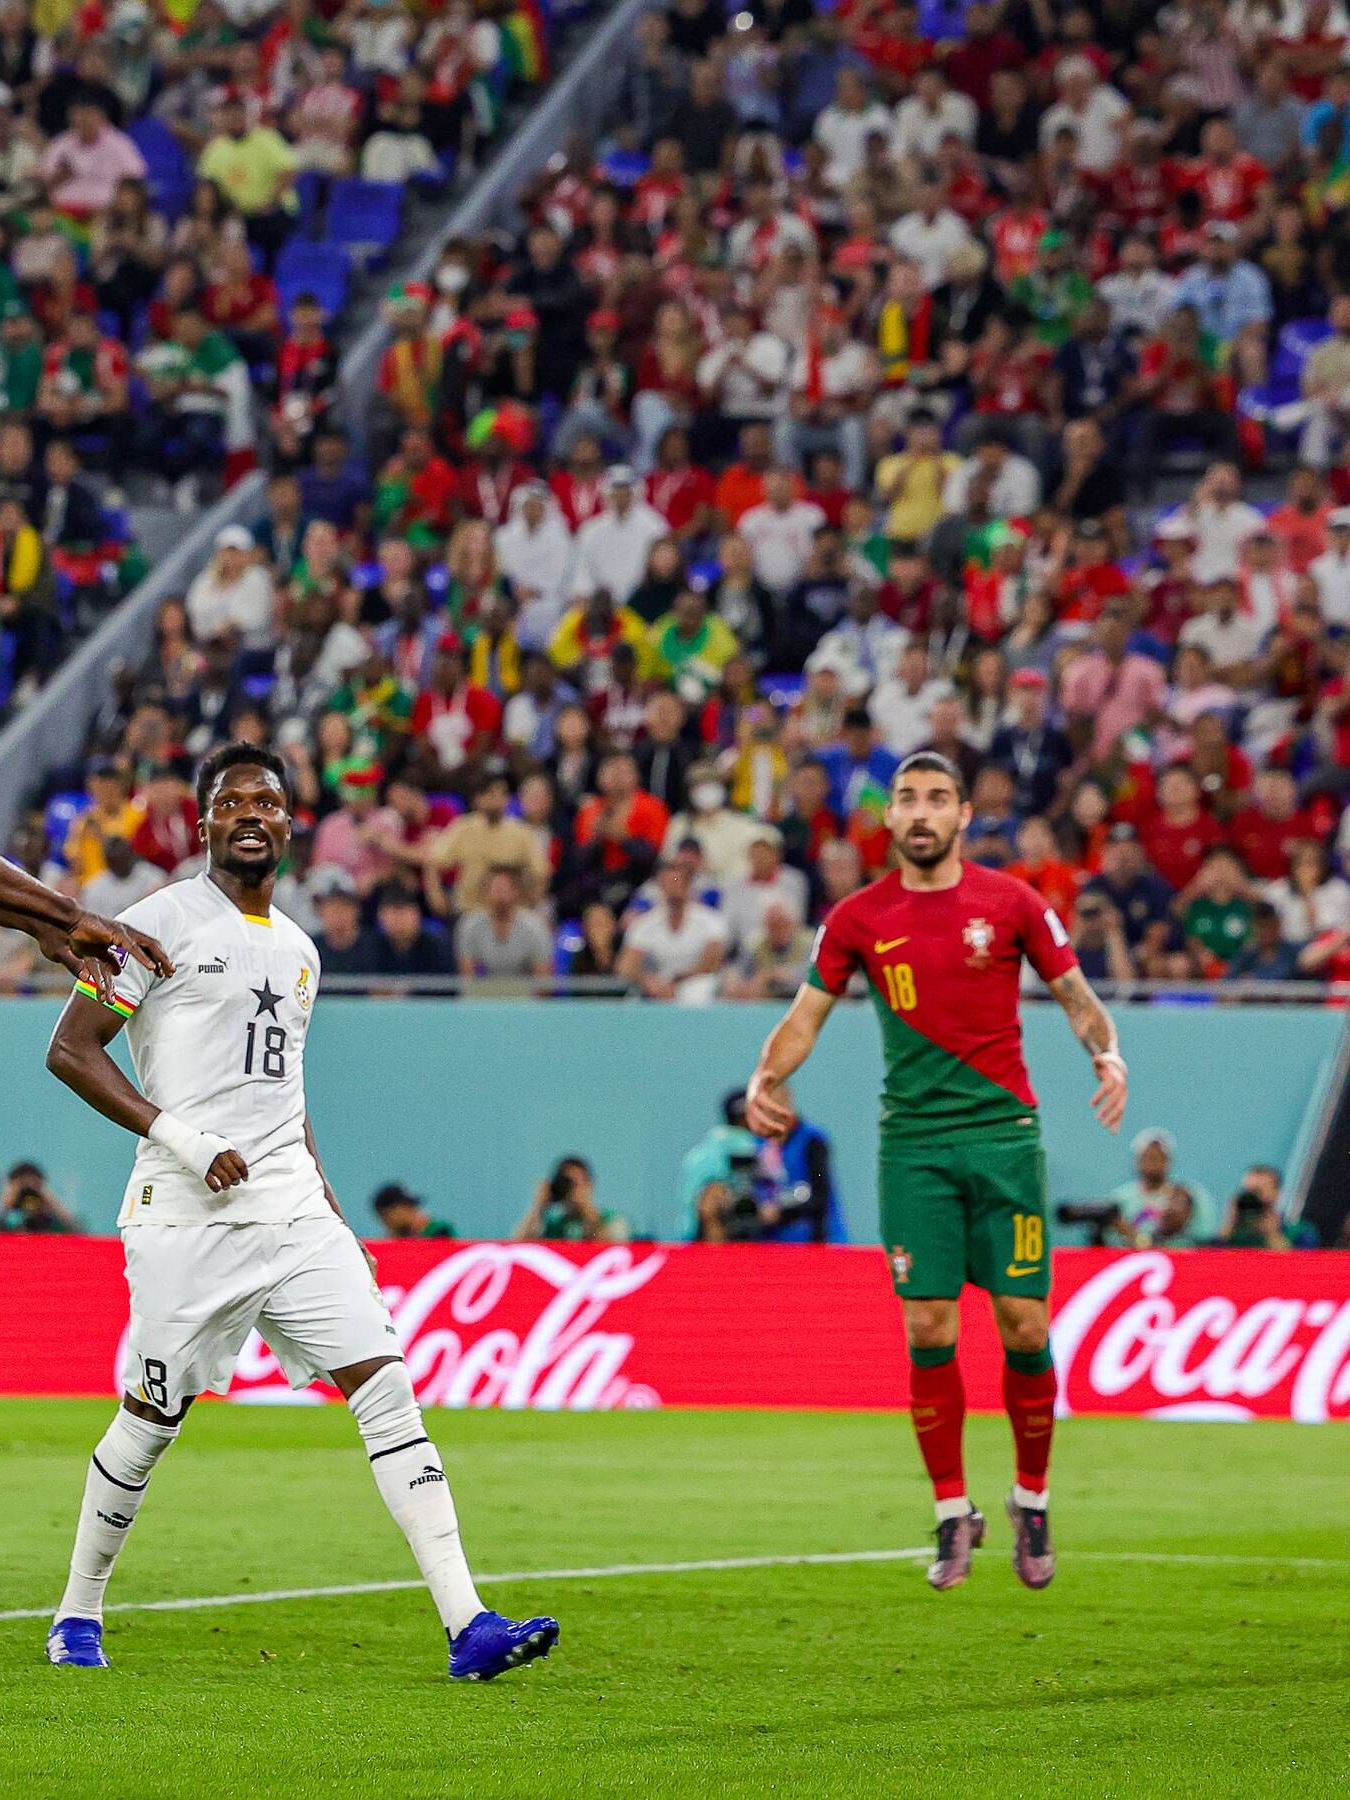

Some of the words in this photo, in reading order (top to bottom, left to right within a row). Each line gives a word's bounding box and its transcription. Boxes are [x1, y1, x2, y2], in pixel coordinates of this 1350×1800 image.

[198, 964, 225, 974] PUMA
[881, 961, 918, 1012] 18
[244, 1021, 287, 1079] 18
[1012, 1212, 1044, 1263] 18
